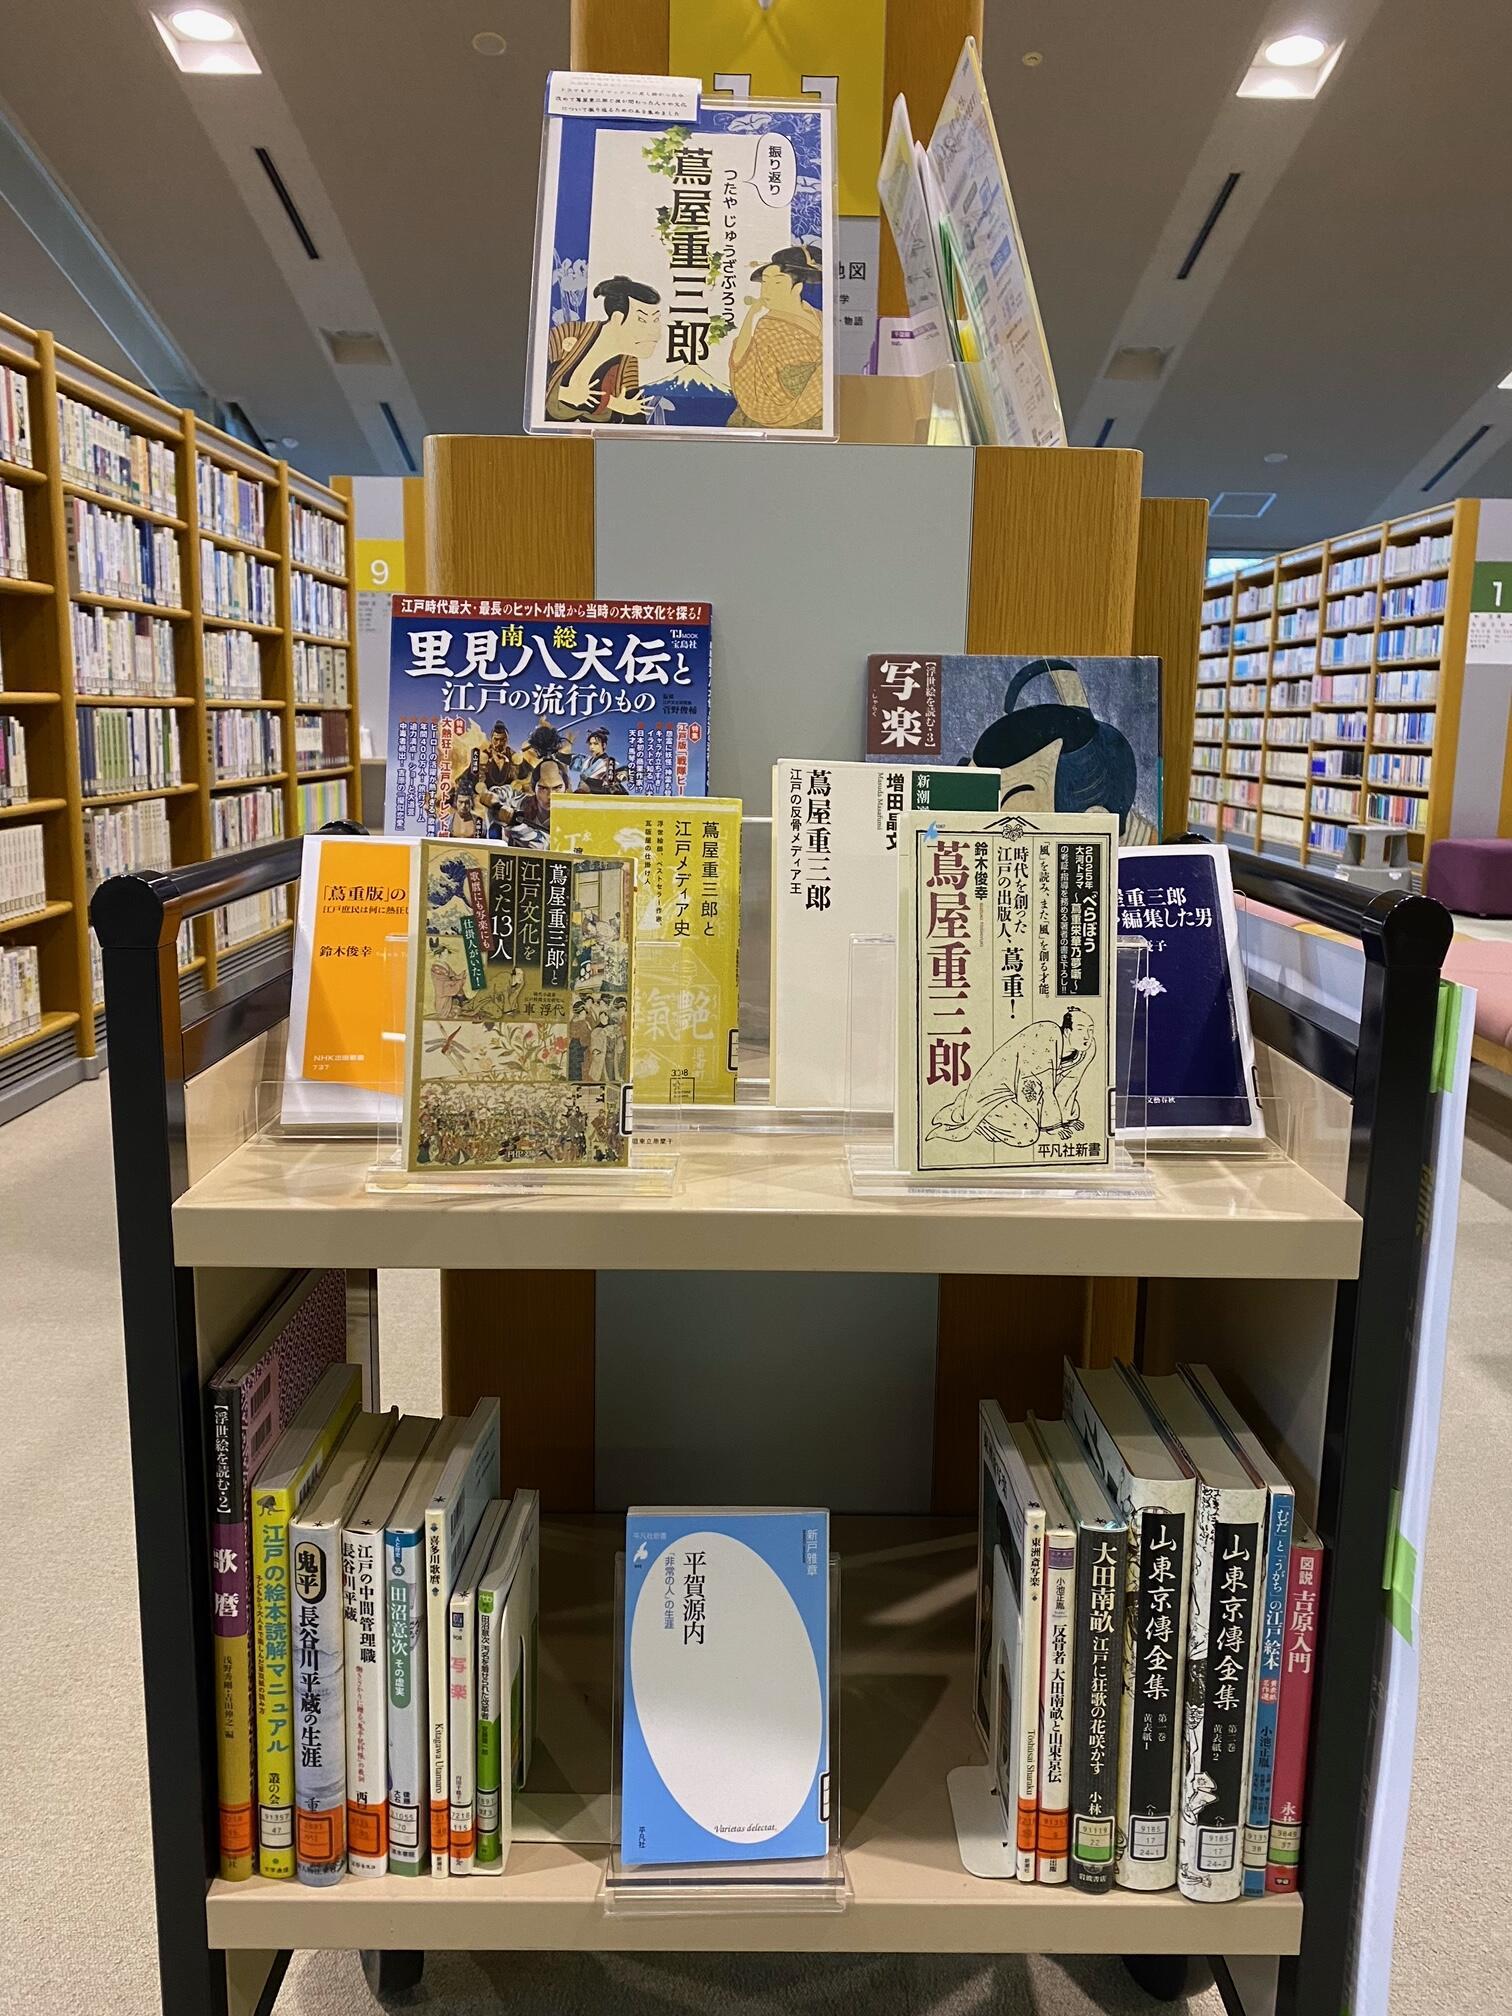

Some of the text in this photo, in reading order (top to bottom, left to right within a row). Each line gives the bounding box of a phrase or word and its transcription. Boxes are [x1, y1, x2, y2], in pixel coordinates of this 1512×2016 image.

[768, 145, 783, 197] 振り返り
[666, 147, 713, 366] 蔦屋重三郎
[721, 169, 737, 326] つたや じゅうざぶろう
[370, 559, 389, 586] 9
[1492, 581, 1503, 607] 1
[404, 629, 692, 686] 里見八犬伝と
[671, 640, 698, 649] 宝島社
[441, 680, 657, 717] 江戸の流行りもの
[879, 659, 923, 749] 写楽
[790, 769, 803, 895] 江戸の反骨メディア王
[805, 768, 833, 912] 蔦屋重三郎
[1074, 845, 1085, 889] 大河ドラマ
[1084, 845, 1094, 889] 2025年
[323, 884, 407, 902] 「蔦重版」の
[674, 821, 692, 937] 江戸メディア史
[701, 821, 720, 937] 蔦屋重三郎と
[974, 841, 988, 901] 鈴木俊幸
[1013, 845, 1030, 935] 時代を創った
[468, 871, 491, 950] 歌麿にも写楽にも
[490, 858, 514, 961] 創った13人
[518, 861, 540, 962] 江戸文化を
[544, 864, 568, 986] 蔦屋重三郎と
[319, 945, 373, 958] 鈴木俊幸
[462, 919, 483, 989] 仕掛人がいた!
[925, 839, 972, 1087] 蔦屋重三郎
[1001, 948, 1025, 1019] 蔦重!
[523, 1002, 565, 1017] 車 浮代
[1037, 1142, 1101, 1158] 平凡社新書
[213, 1548, 241, 1618] 歌麿
[296, 1551, 319, 1595] 鬼平
[342, 1543, 358, 1623] 長谷川平蔵
[429, 1535, 441, 1585] 喜多川歌麿
[664, 1552, 675, 1630] 「非常の人」の生涯
[357, 1544, 377, 1664] 江戸の中間管理職
[390, 1585, 408, 1657] 田沼意次
[683, 1550, 707, 1646] 平賀源内
[1142, 1523, 1178, 1701] 山東京傳全集
[1213, 1533, 1251, 1711] 山東京傳全集
[1287, 1556, 1317, 1674] 図説 吉原入門
[262, 1524, 289, 1754] 江戸の絵本読解マニュアル
[1051, 1624, 1068, 1665] 反骨者
[1088, 1541, 1118, 1775] 大田南畝 江戸に狂歌の花咲かす
[298, 1605, 322, 1768] 長谷川平蔵の生涯
[450, 1658, 467, 1699] 写楽
[268, 1772, 282, 1806] 叢の会
[432, 1722, 444, 1794] Kitagawa Utamaro
[713, 1823, 746, 1835] Varietas
[1088, 1790, 1103, 1816] 小林
